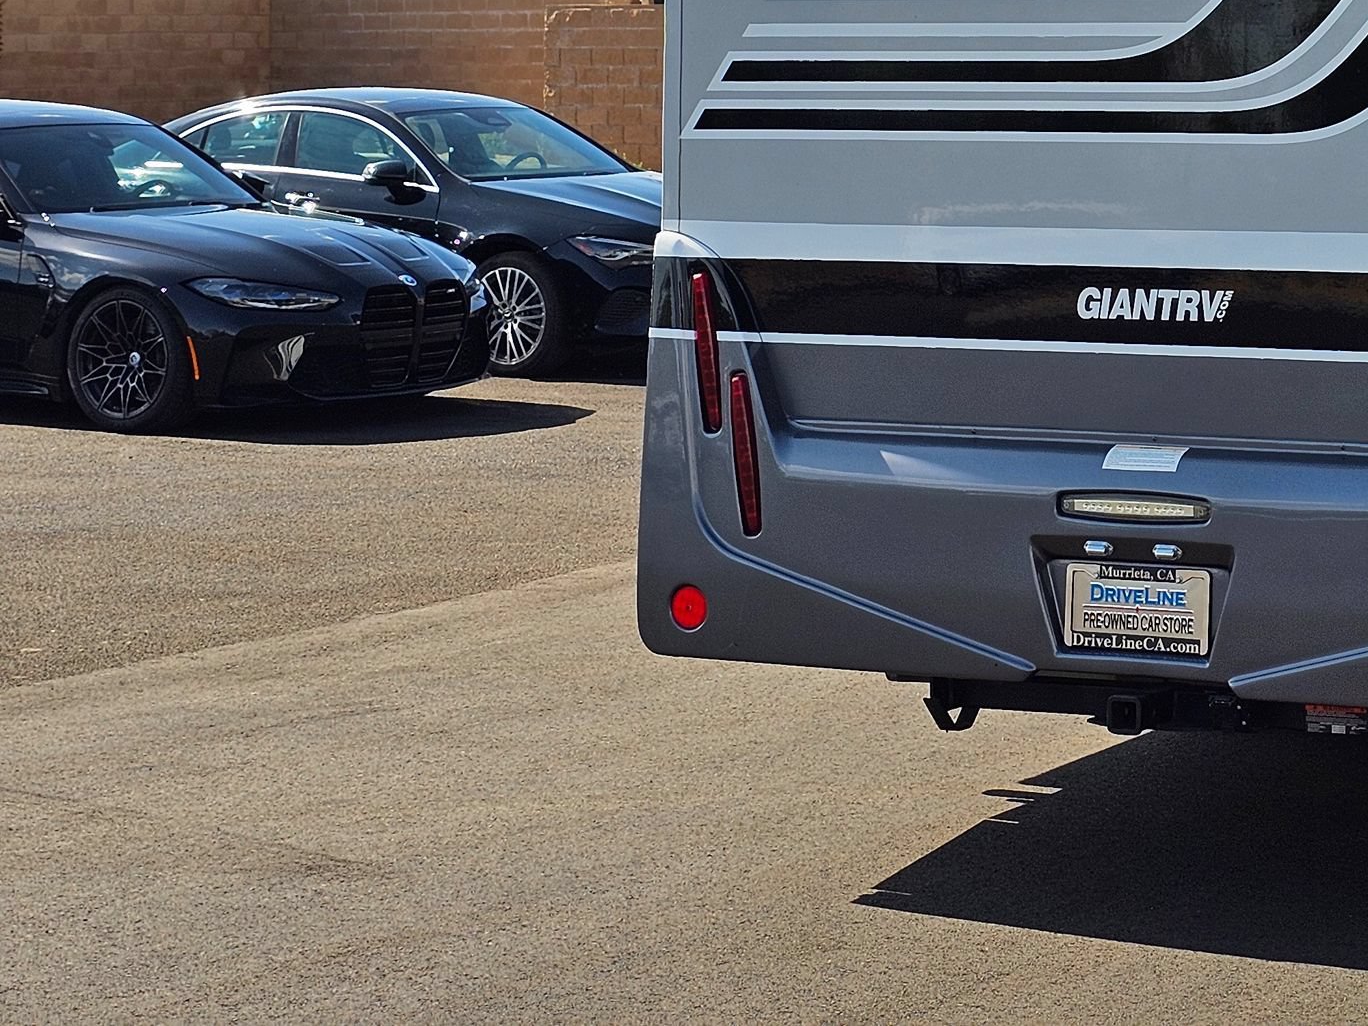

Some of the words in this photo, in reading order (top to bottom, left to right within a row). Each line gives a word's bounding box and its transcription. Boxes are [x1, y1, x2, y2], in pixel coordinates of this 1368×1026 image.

[1076, 286, 1224, 322] GIANTRV
[1215, 290, 1234, 323] .COM
[1101, 566, 1154, 581] Murrieta,
[1156, 569, 1175, 581] CA
[1083, 611, 1139, 631] PRE-OWNED
[1141, 615, 1162, 632] CAR
[1163, 617, 1194, 635] STORE
[1073, 633, 1199, 653] DriveLineCA.com
